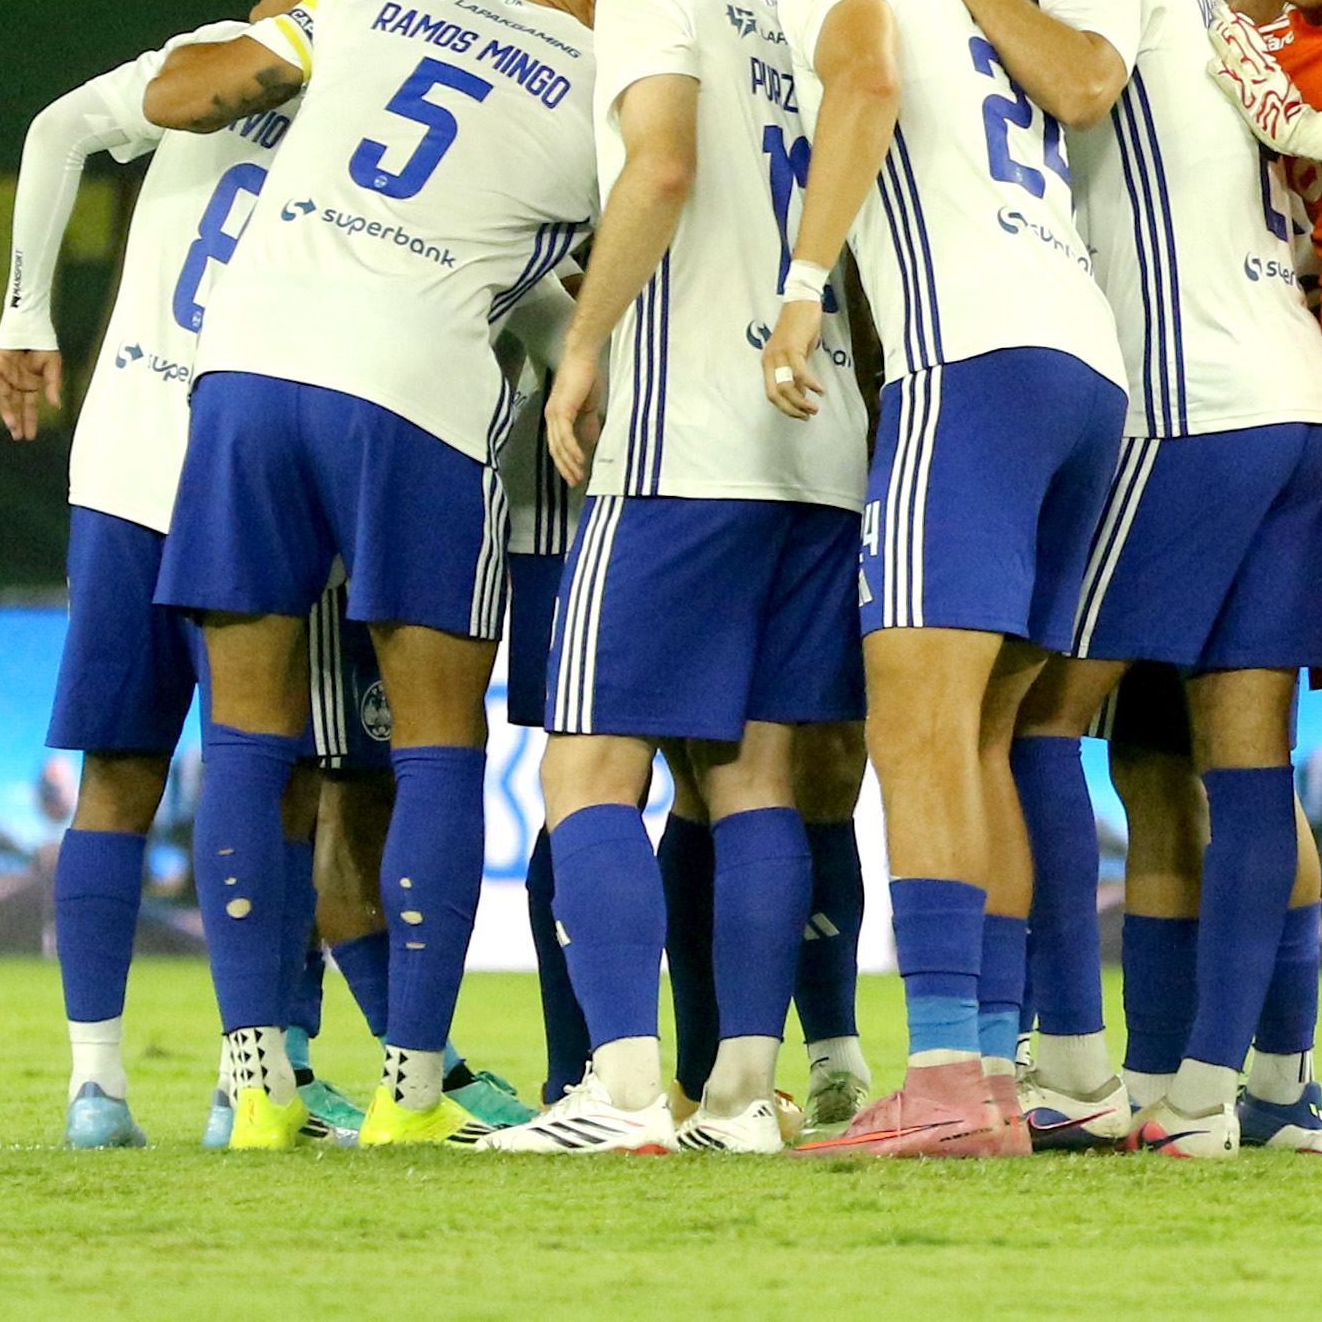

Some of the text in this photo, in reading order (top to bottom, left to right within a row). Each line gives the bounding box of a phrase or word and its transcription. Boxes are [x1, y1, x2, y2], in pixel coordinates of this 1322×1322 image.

[370, 2, 571, 110] RAMOS MINGO
[454, 0, 583, 59] LAPAKGAMING
[349, 56, 494, 199] 5
[320, 208, 456, 269] superbank
